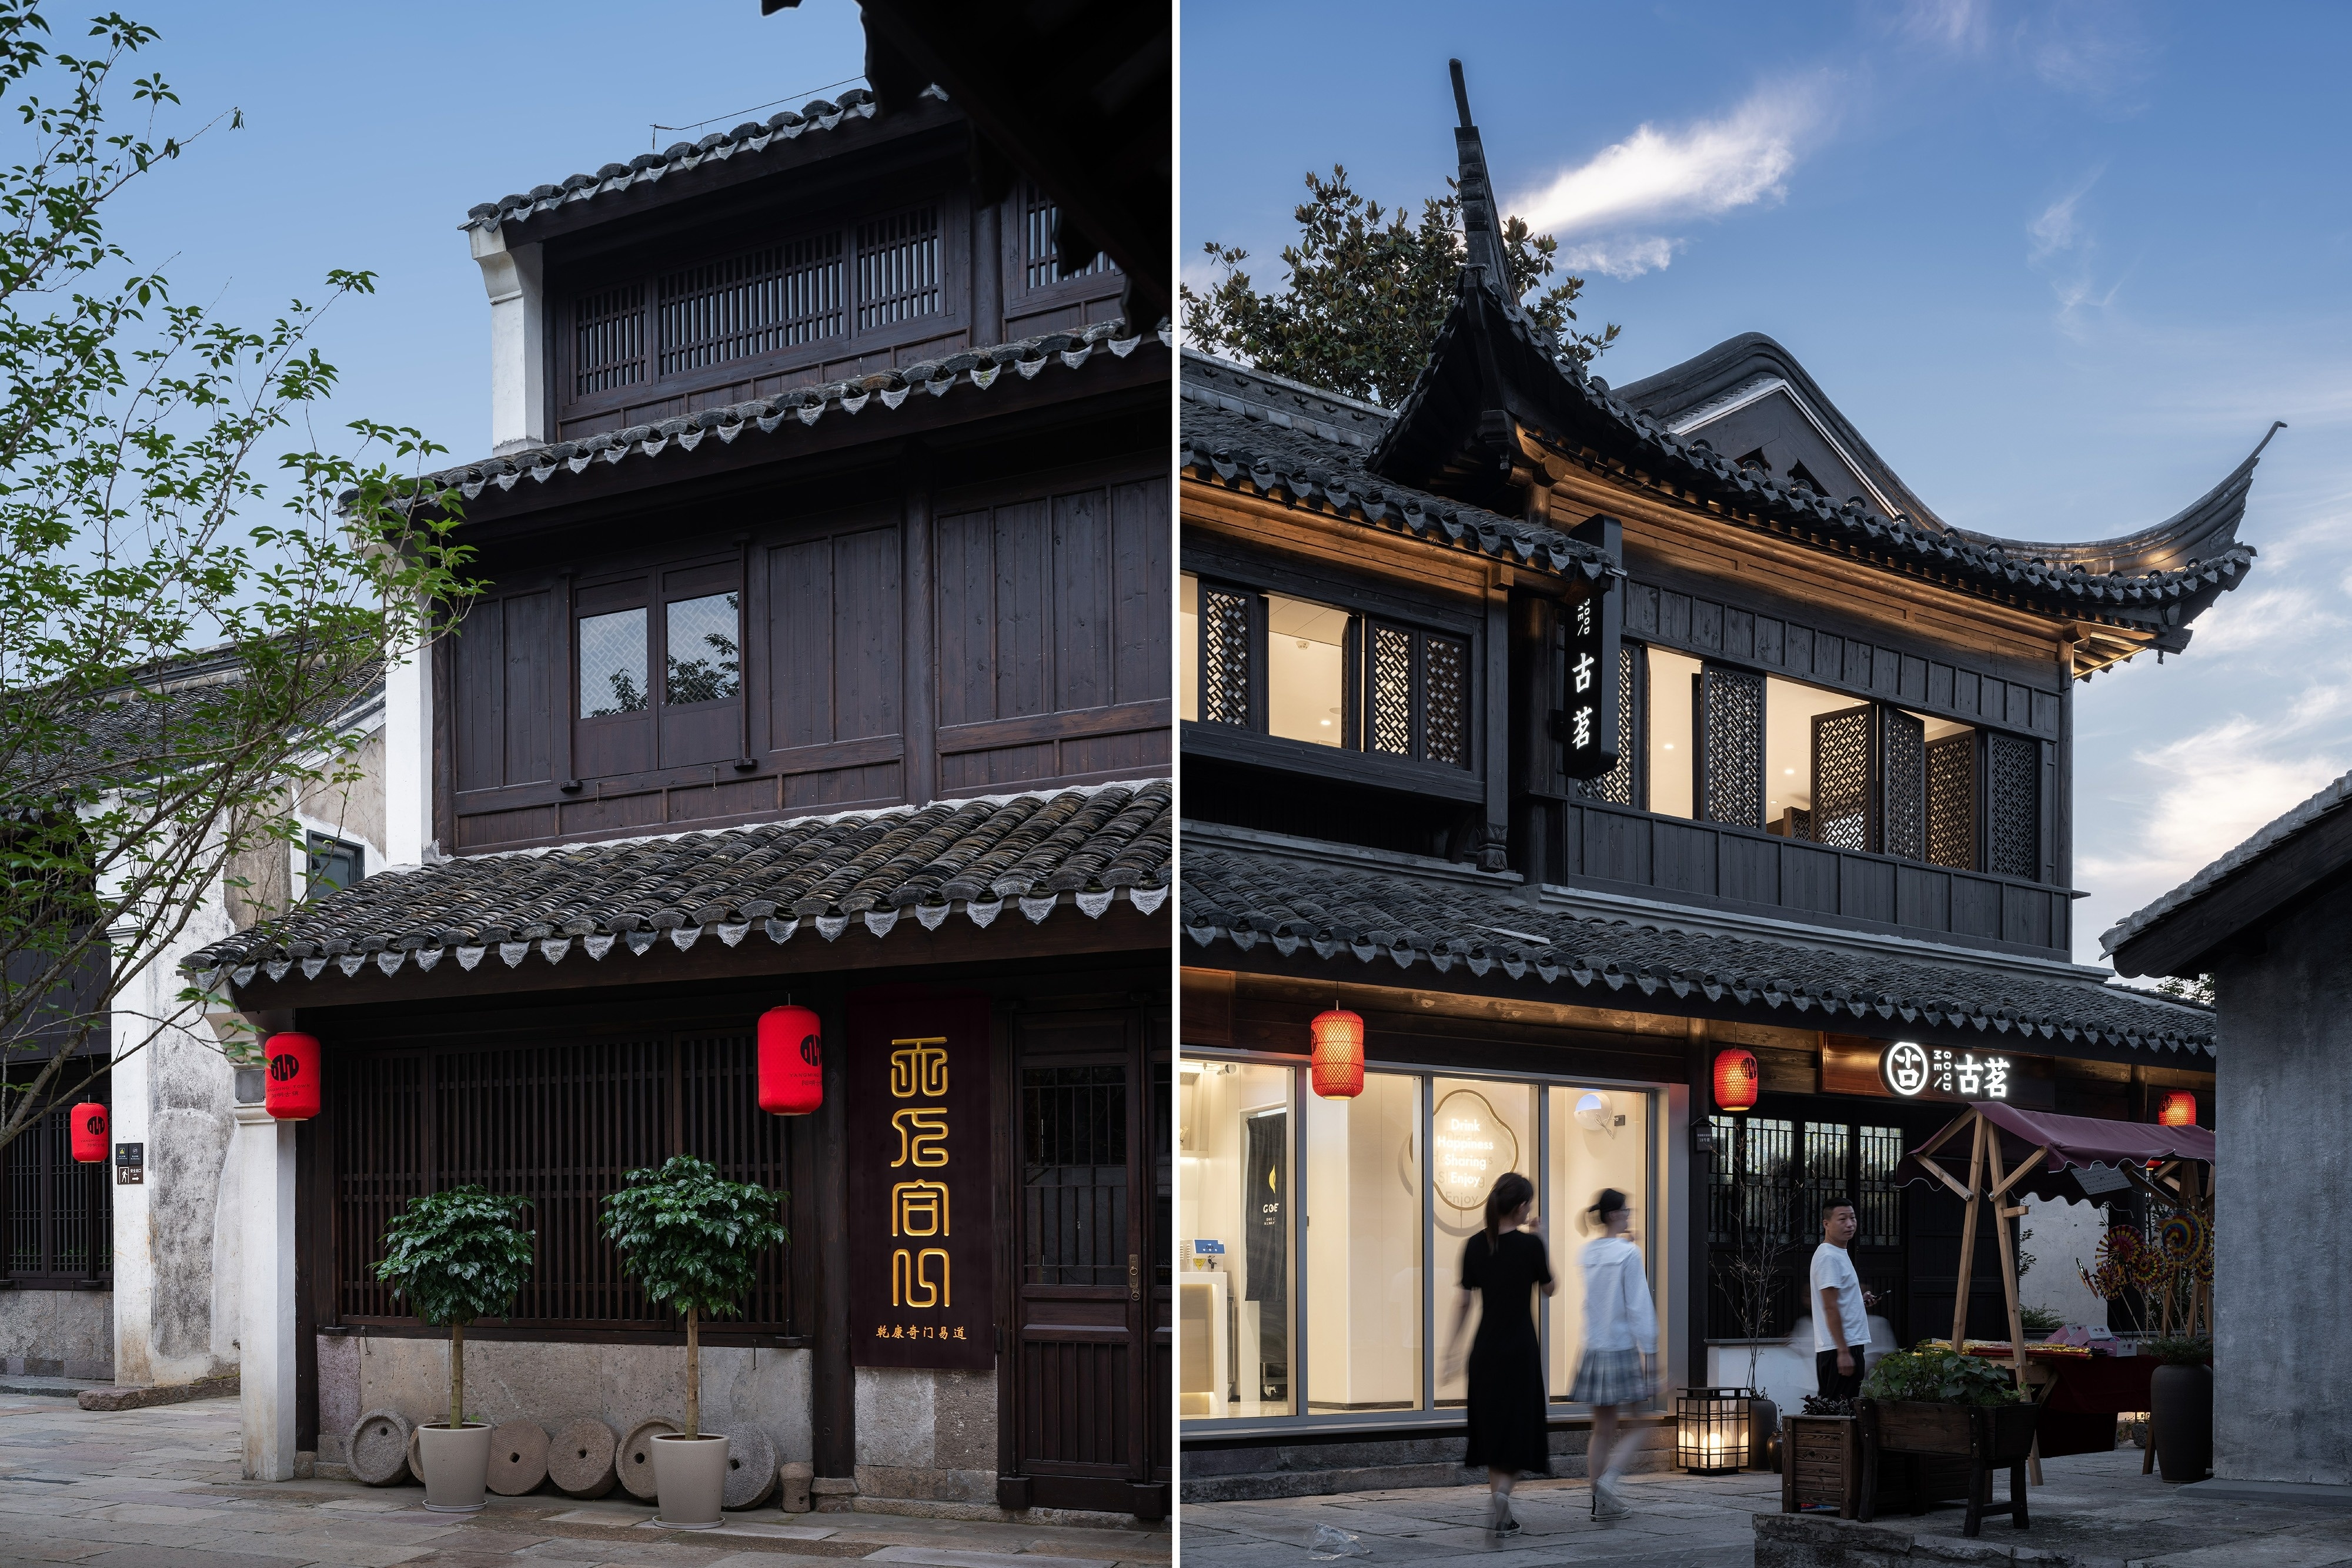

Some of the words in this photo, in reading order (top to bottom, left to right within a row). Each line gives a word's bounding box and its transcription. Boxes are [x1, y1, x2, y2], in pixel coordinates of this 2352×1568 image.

[1572, 653, 1595, 750] 古茗
[1943, 1051, 1952, 1091] GOOD
[1954, 1054, 2010, 1098] 古茗
[1451, 1118, 1481, 1132] Drink
[1437, 1135, 1494, 1152] Happiness
[1444, 1153, 1486, 1171] Sharing
[1450, 1171, 1481, 1188] Enjoy
[876, 1324, 967, 1340] 乾康奇门易道
